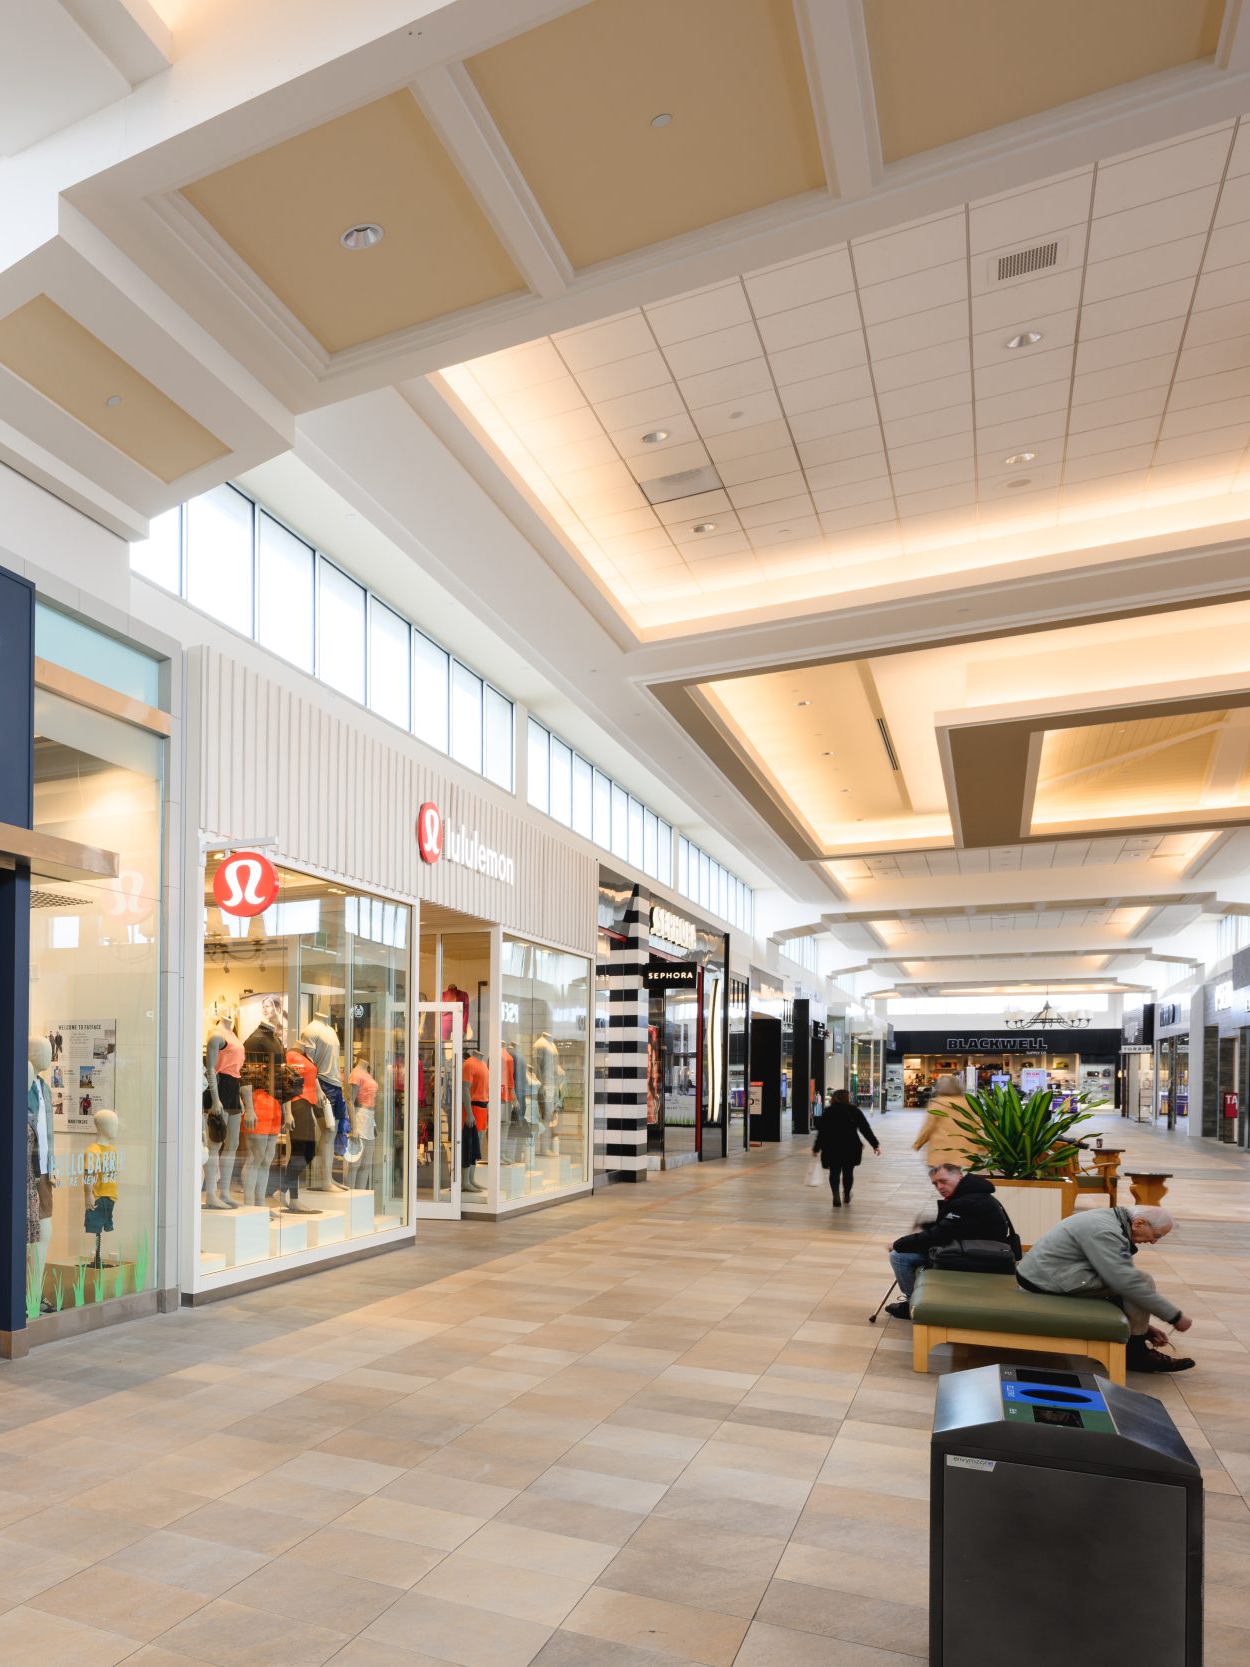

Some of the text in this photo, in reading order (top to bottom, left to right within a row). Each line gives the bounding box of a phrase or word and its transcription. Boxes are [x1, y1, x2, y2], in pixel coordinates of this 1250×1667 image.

[446, 817, 514, 886] lululemon
[648, 972, 693, 980] SEPHORA
[947, 1038, 1048, 1050] BLACKWELL
